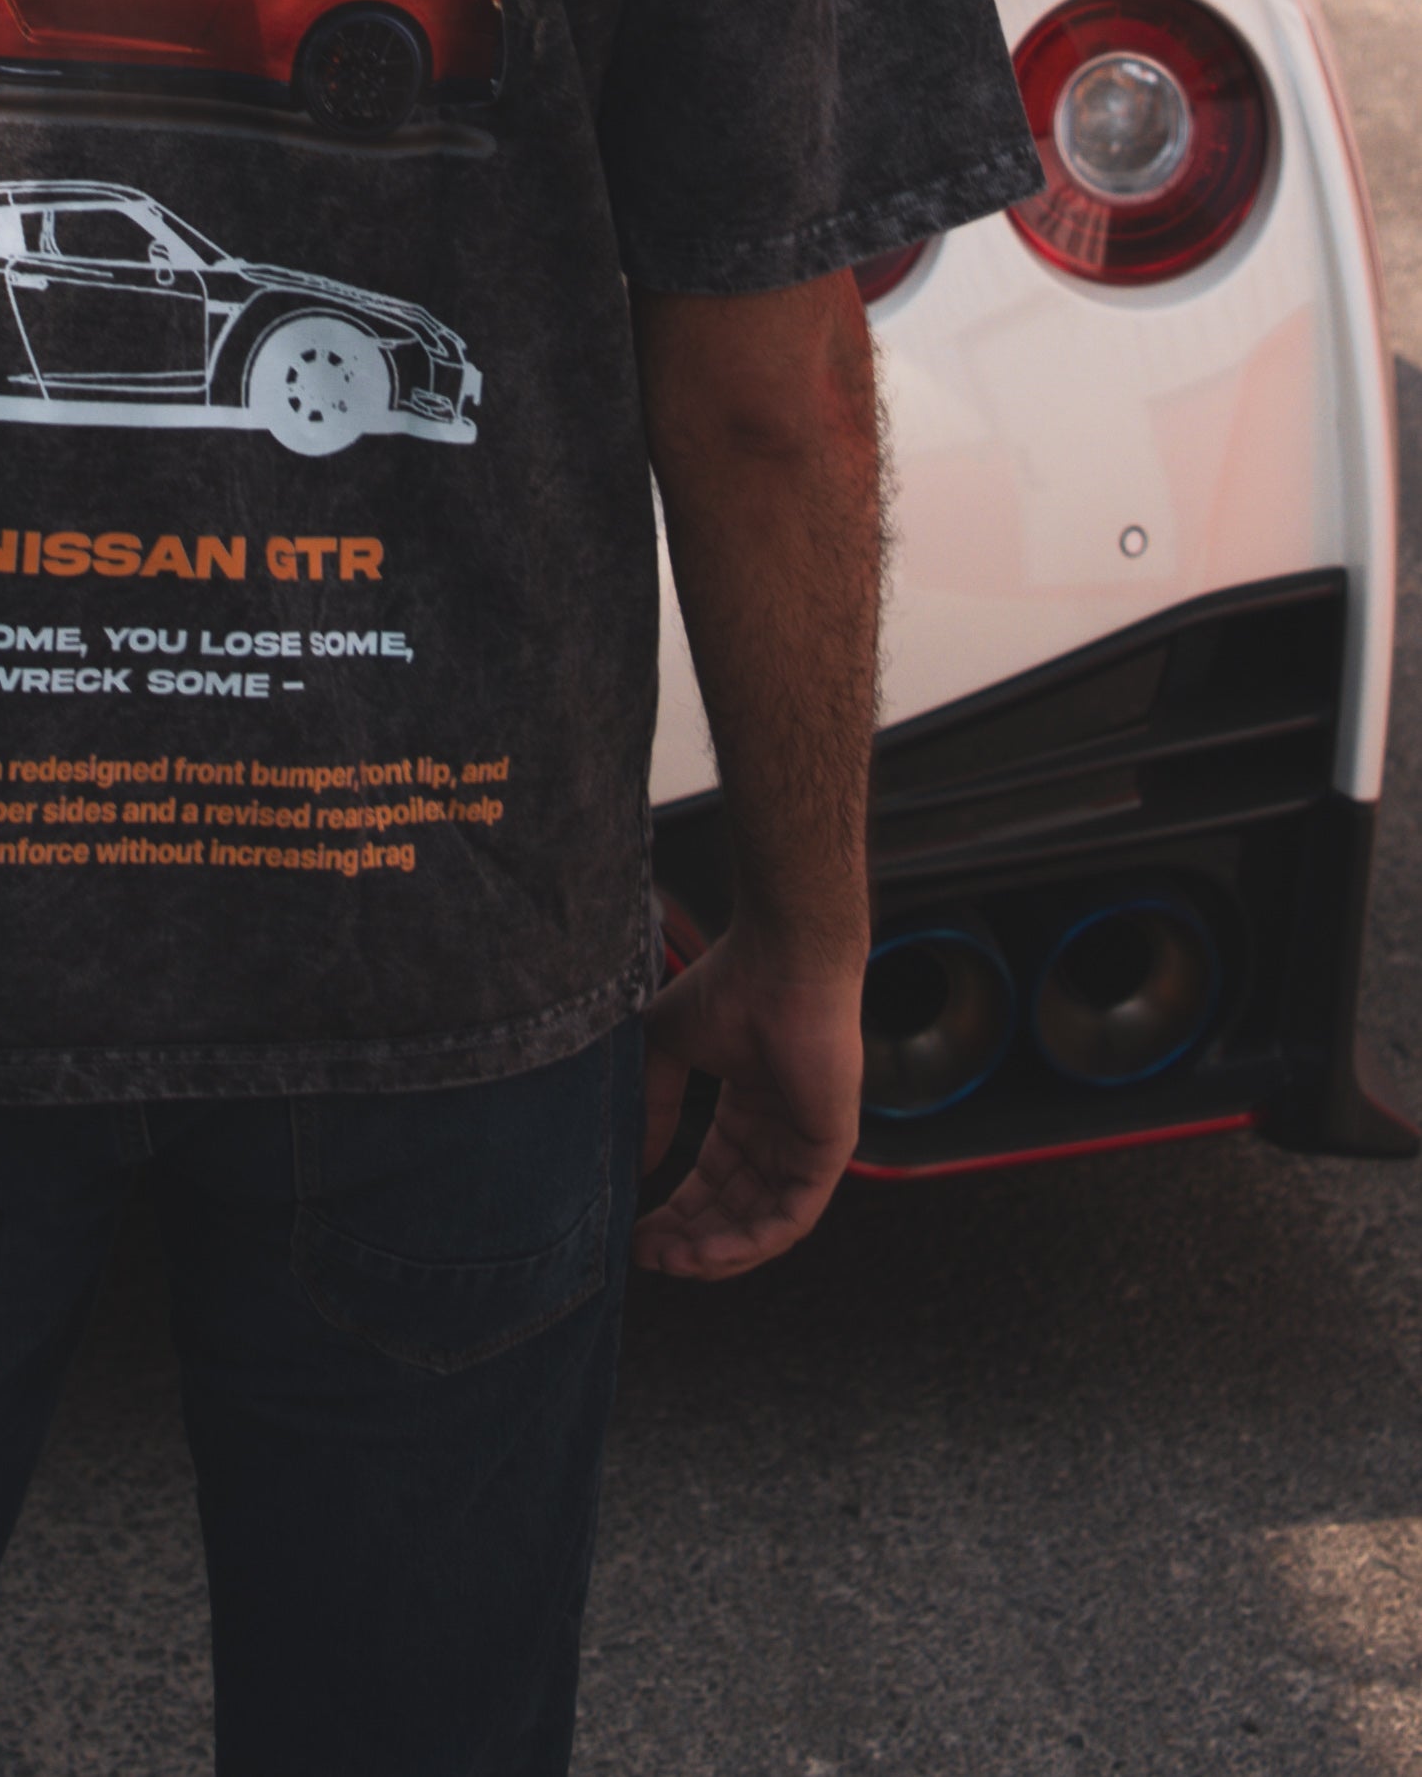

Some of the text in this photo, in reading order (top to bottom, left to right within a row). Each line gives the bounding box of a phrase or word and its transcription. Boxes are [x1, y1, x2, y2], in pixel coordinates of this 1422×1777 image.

[265, 535, 385, 581] GTR
[103, 626, 188, 654] YOU
[200, 630, 303, 658] LOSE
[309, 630, 415, 663] SOME,
[147, 669, 270, 698] SOME
[8, 754, 168, 789] redesigned
[174, 756, 245, 785] front
[250, 759, 359, 794] bumper,
[416, 756, 457, 790] lip,
[461, 755, 509, 784] and
[42, 796, 117, 824] sides
[121, 796, 176, 823] and
[181, 802, 199, 824] a
[204, 800, 311, 829] revised
[316, 807, 363, 830] rear
[447, 794, 504, 826] help
[95, 835, 204, 865] without
[209, 837, 359, 877] increasing
[360, 841, 416, 872] drag
